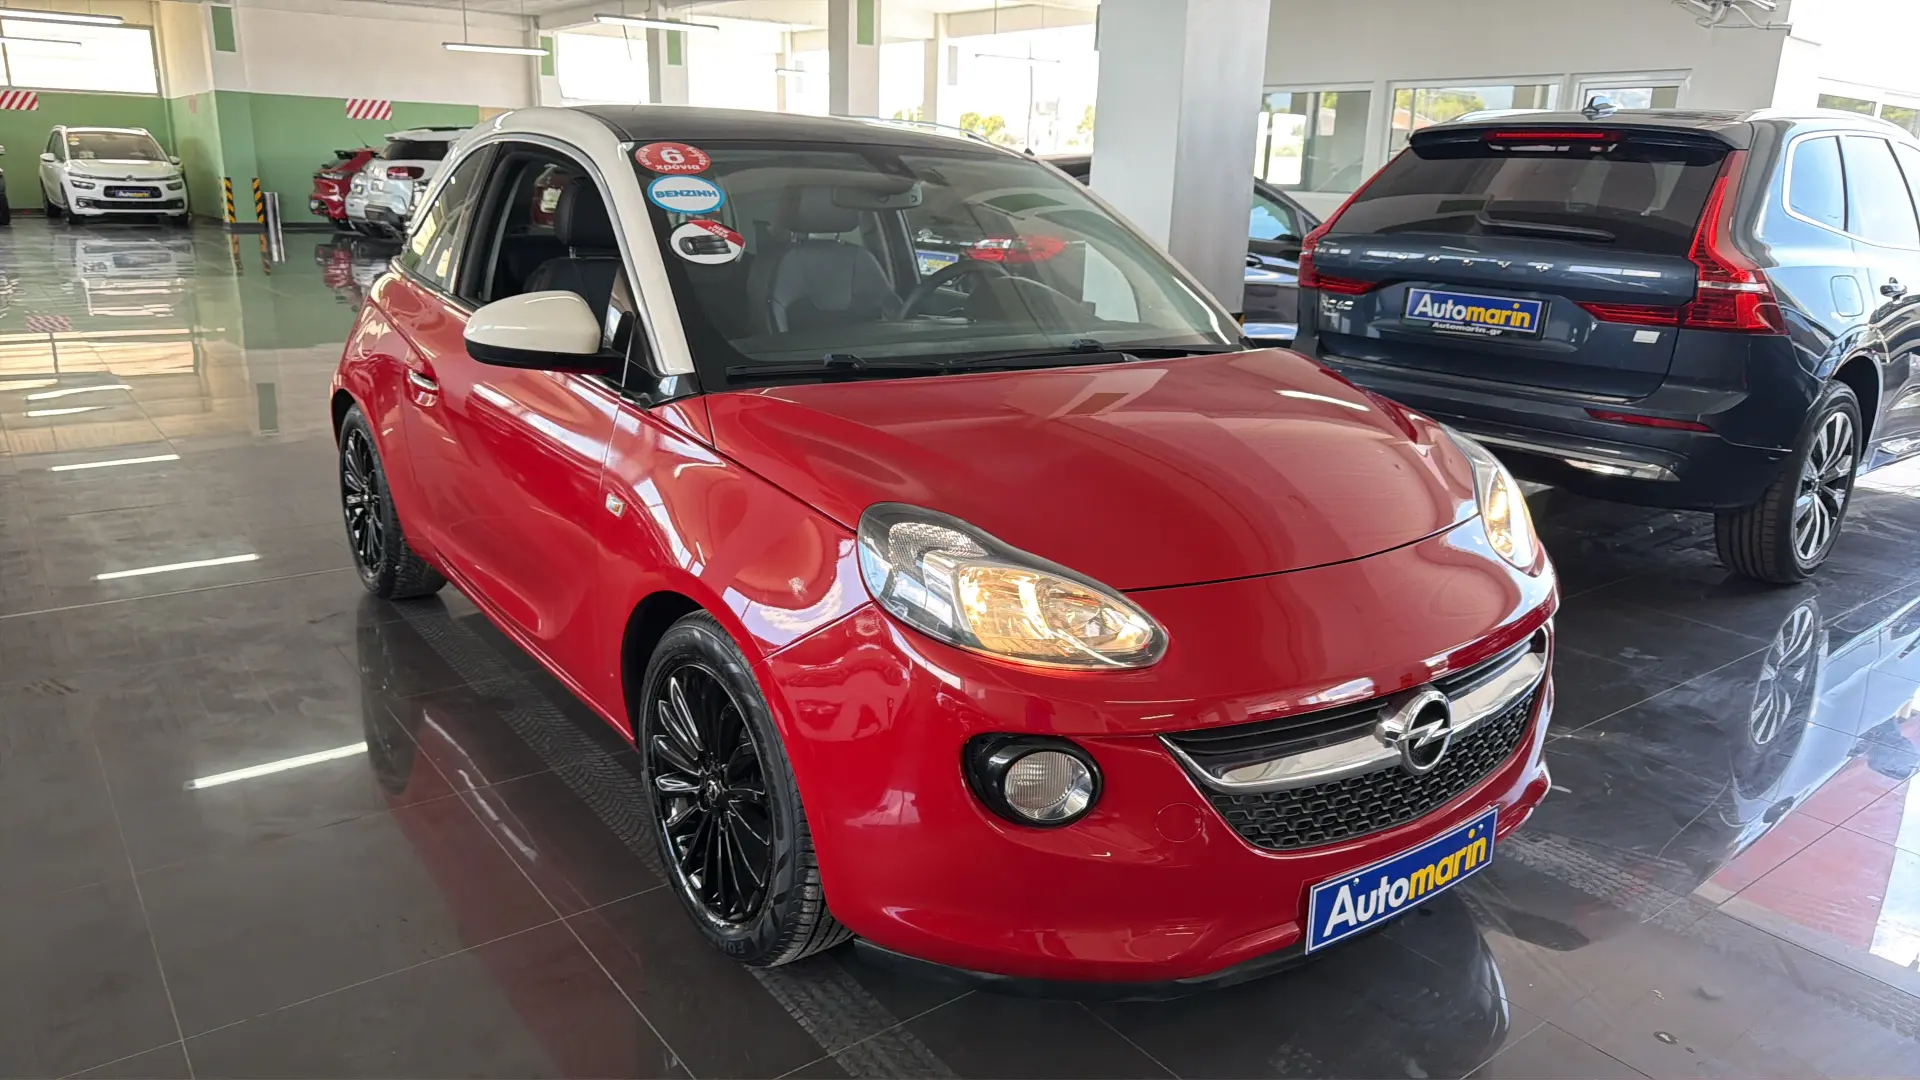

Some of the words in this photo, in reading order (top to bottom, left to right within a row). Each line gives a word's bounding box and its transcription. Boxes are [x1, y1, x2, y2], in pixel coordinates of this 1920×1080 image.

[655, 163, 700, 171] χρόνια
[660, 149, 685, 164] 6
[1413, 293, 1531, 328] Automarin
[1323, 828, 1487, 938] Automarin
